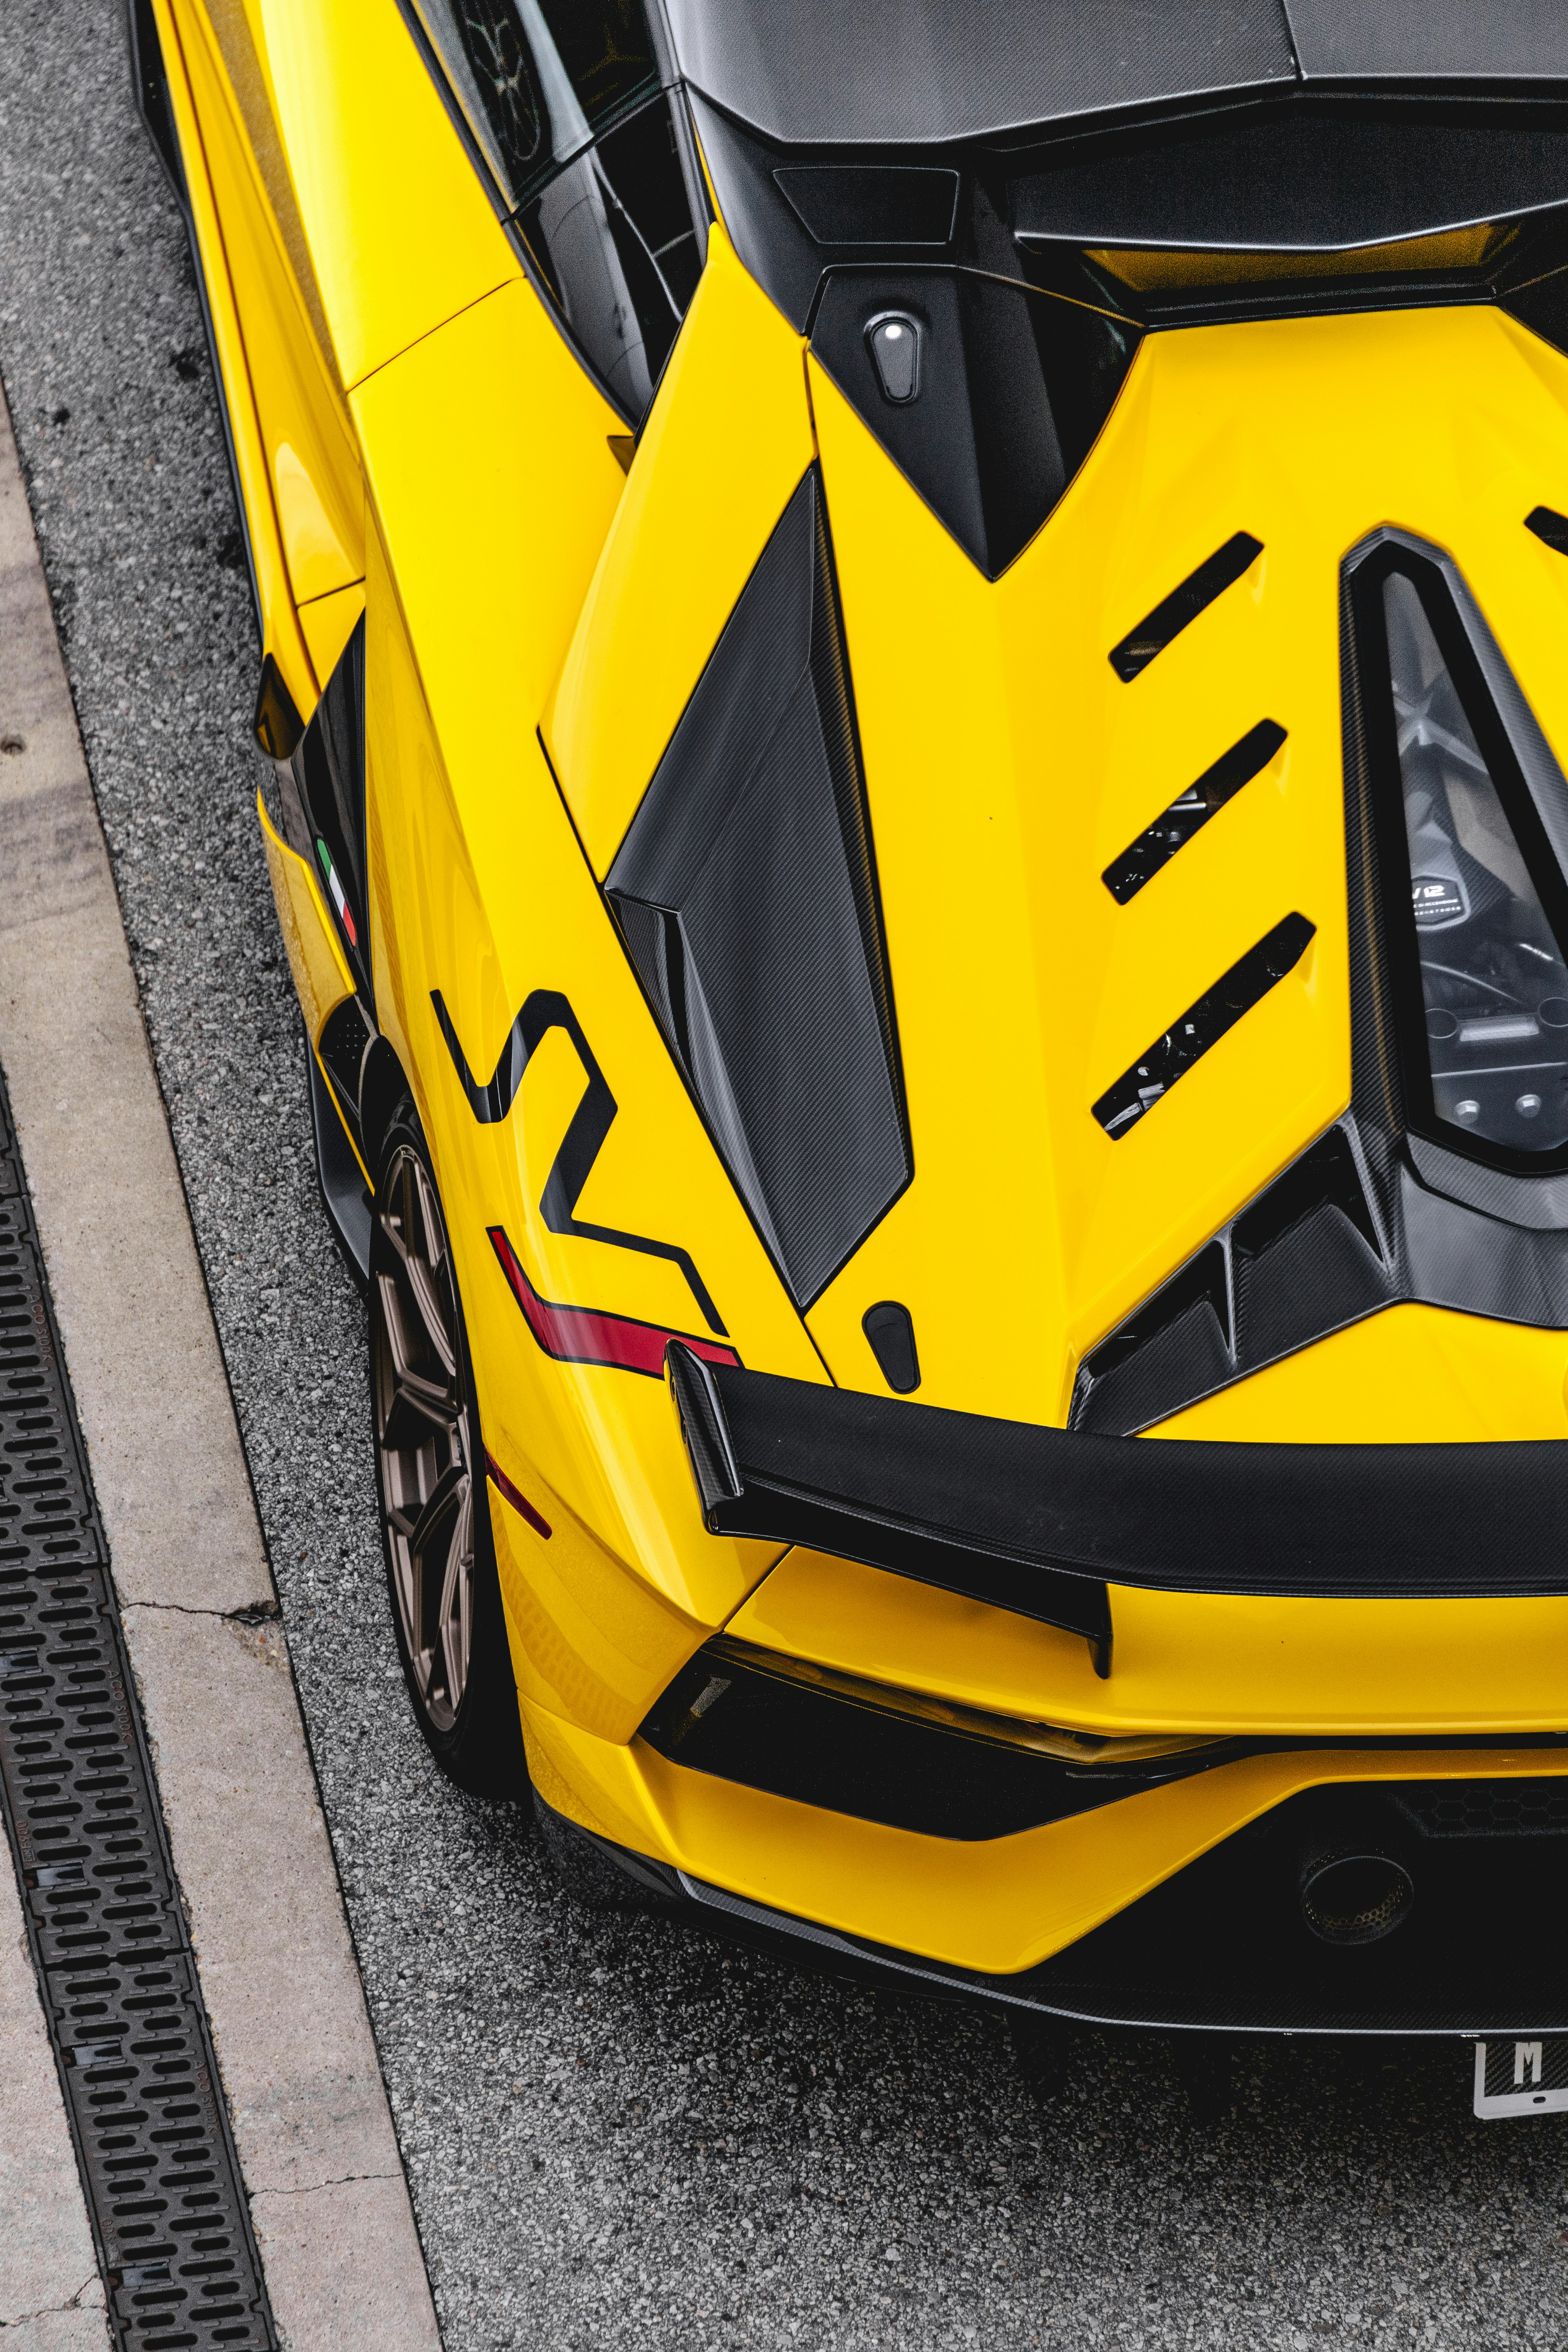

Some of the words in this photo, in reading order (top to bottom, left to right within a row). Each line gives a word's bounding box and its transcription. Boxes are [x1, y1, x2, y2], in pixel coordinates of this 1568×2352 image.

[29, 1295, 45, 1324] ACO
[108, 1670, 124, 1700] ACO
[192, 2061, 211, 2092] ACO
[1514, 2042, 1542, 2084] M
